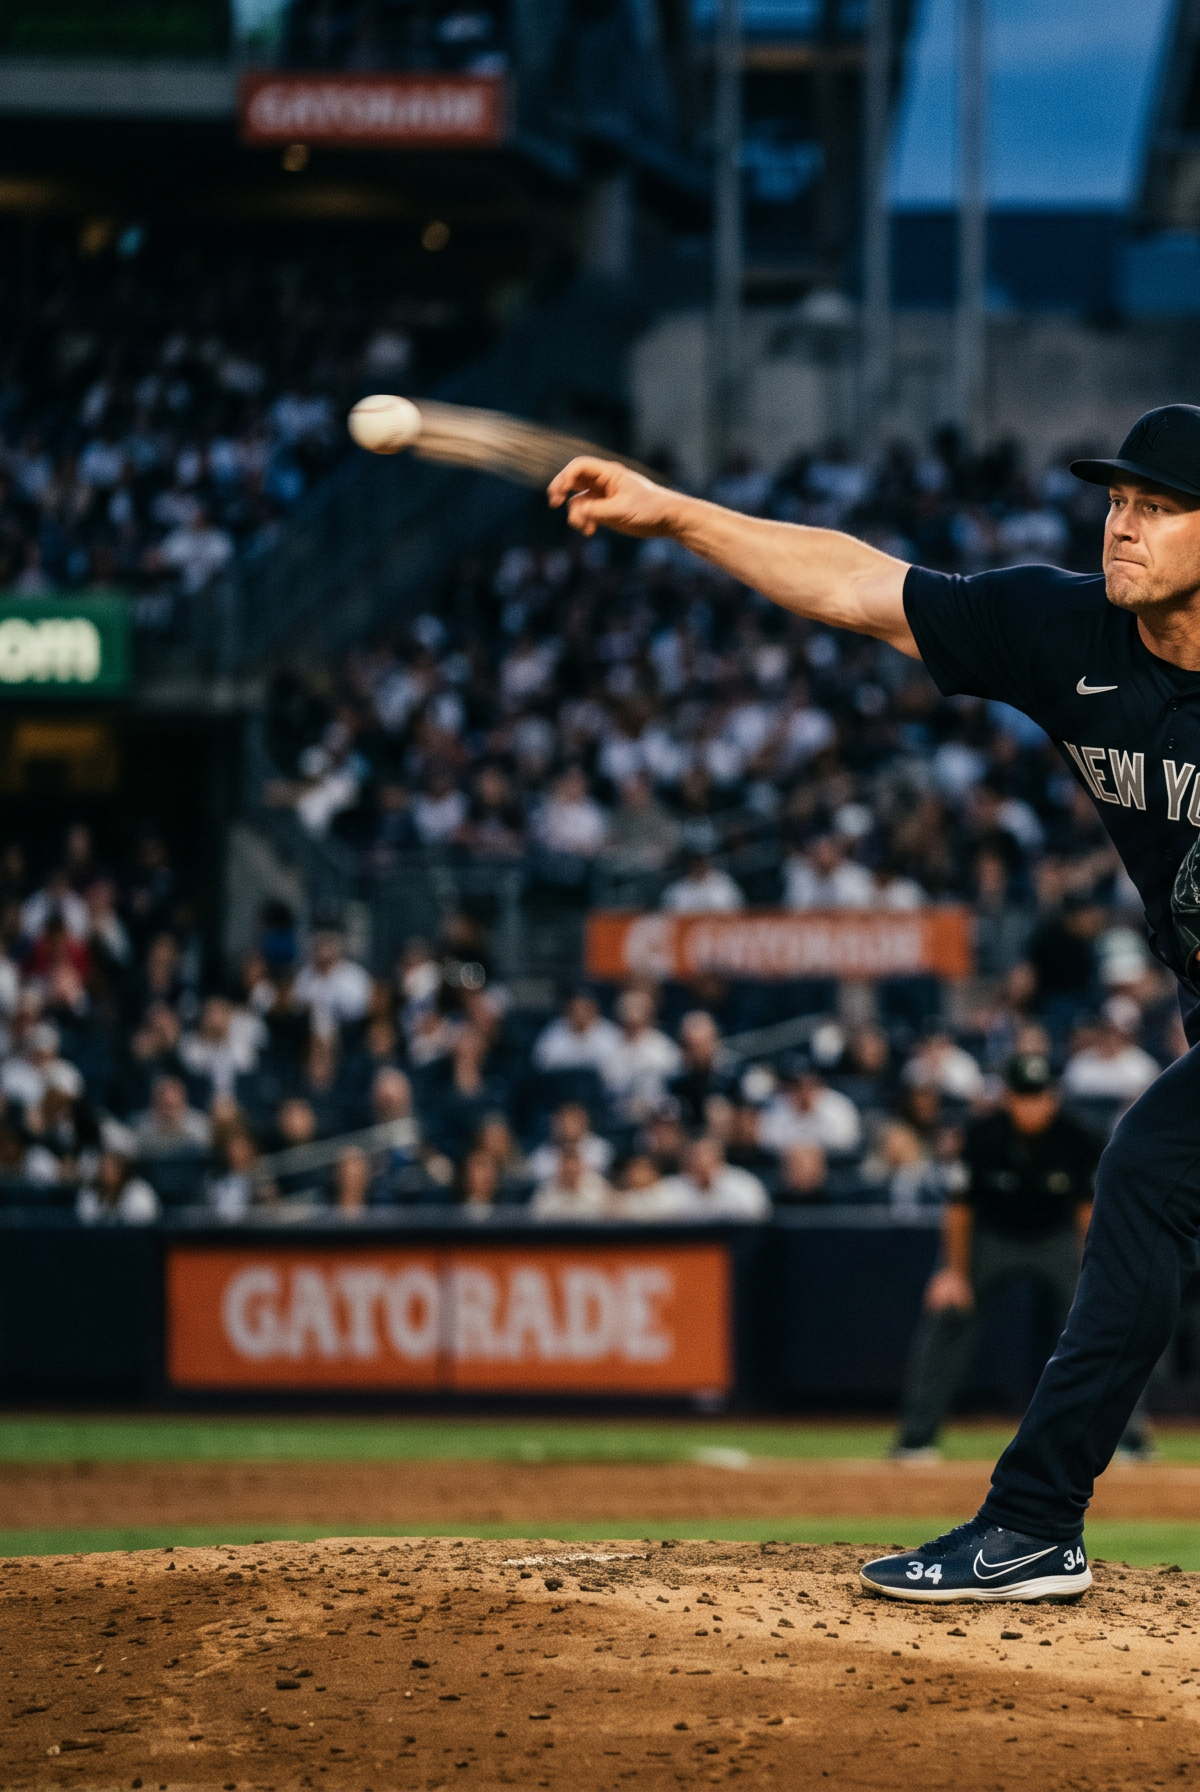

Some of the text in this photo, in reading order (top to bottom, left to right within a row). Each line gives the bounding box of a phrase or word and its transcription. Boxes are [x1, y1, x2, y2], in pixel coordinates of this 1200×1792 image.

[221, 1267, 672, 1362] GATORADE
[1063, 1546, 1085, 1570] 34
[905, 1561, 943, 1585] 34
